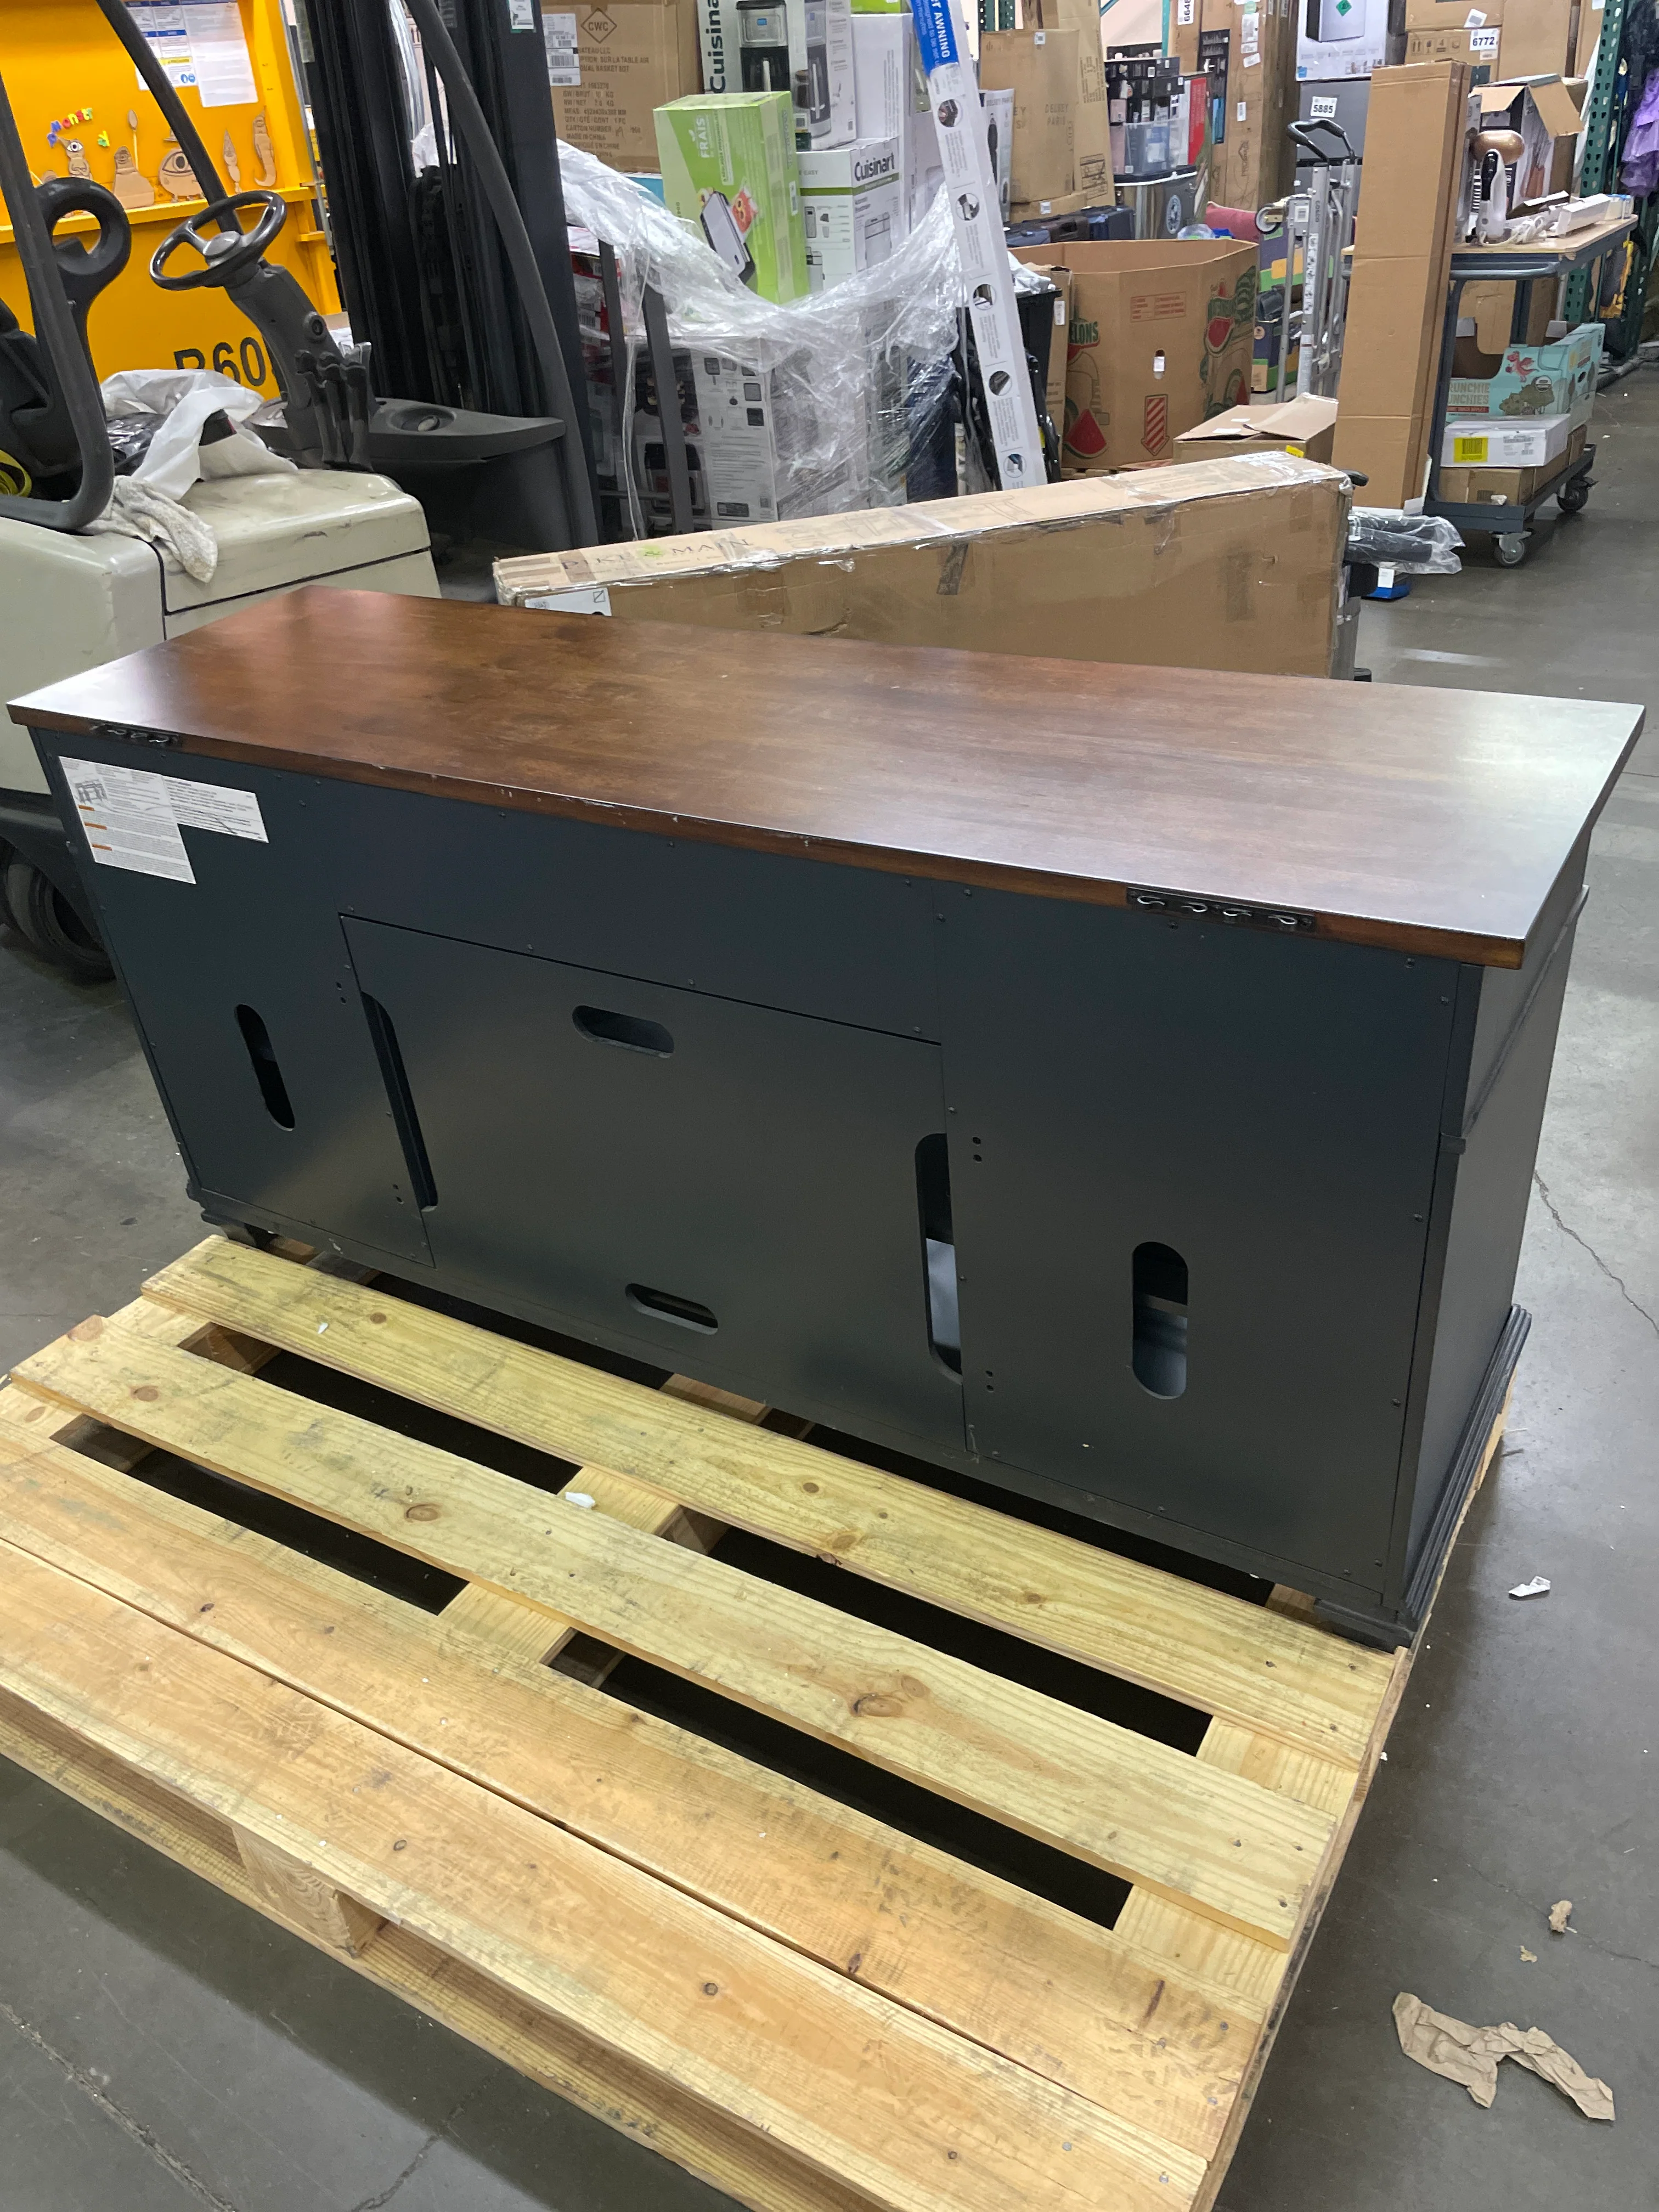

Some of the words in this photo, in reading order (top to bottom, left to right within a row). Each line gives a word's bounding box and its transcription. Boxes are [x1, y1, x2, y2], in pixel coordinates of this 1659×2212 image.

[588, 21, 608, 31] CWC
[934, 12, 950, 58] AWNING
[1472, 37, 1494, 46] 6772
[1313, 104, 1334, 113] 5885
[854, 153, 895, 182] Cuisinart
